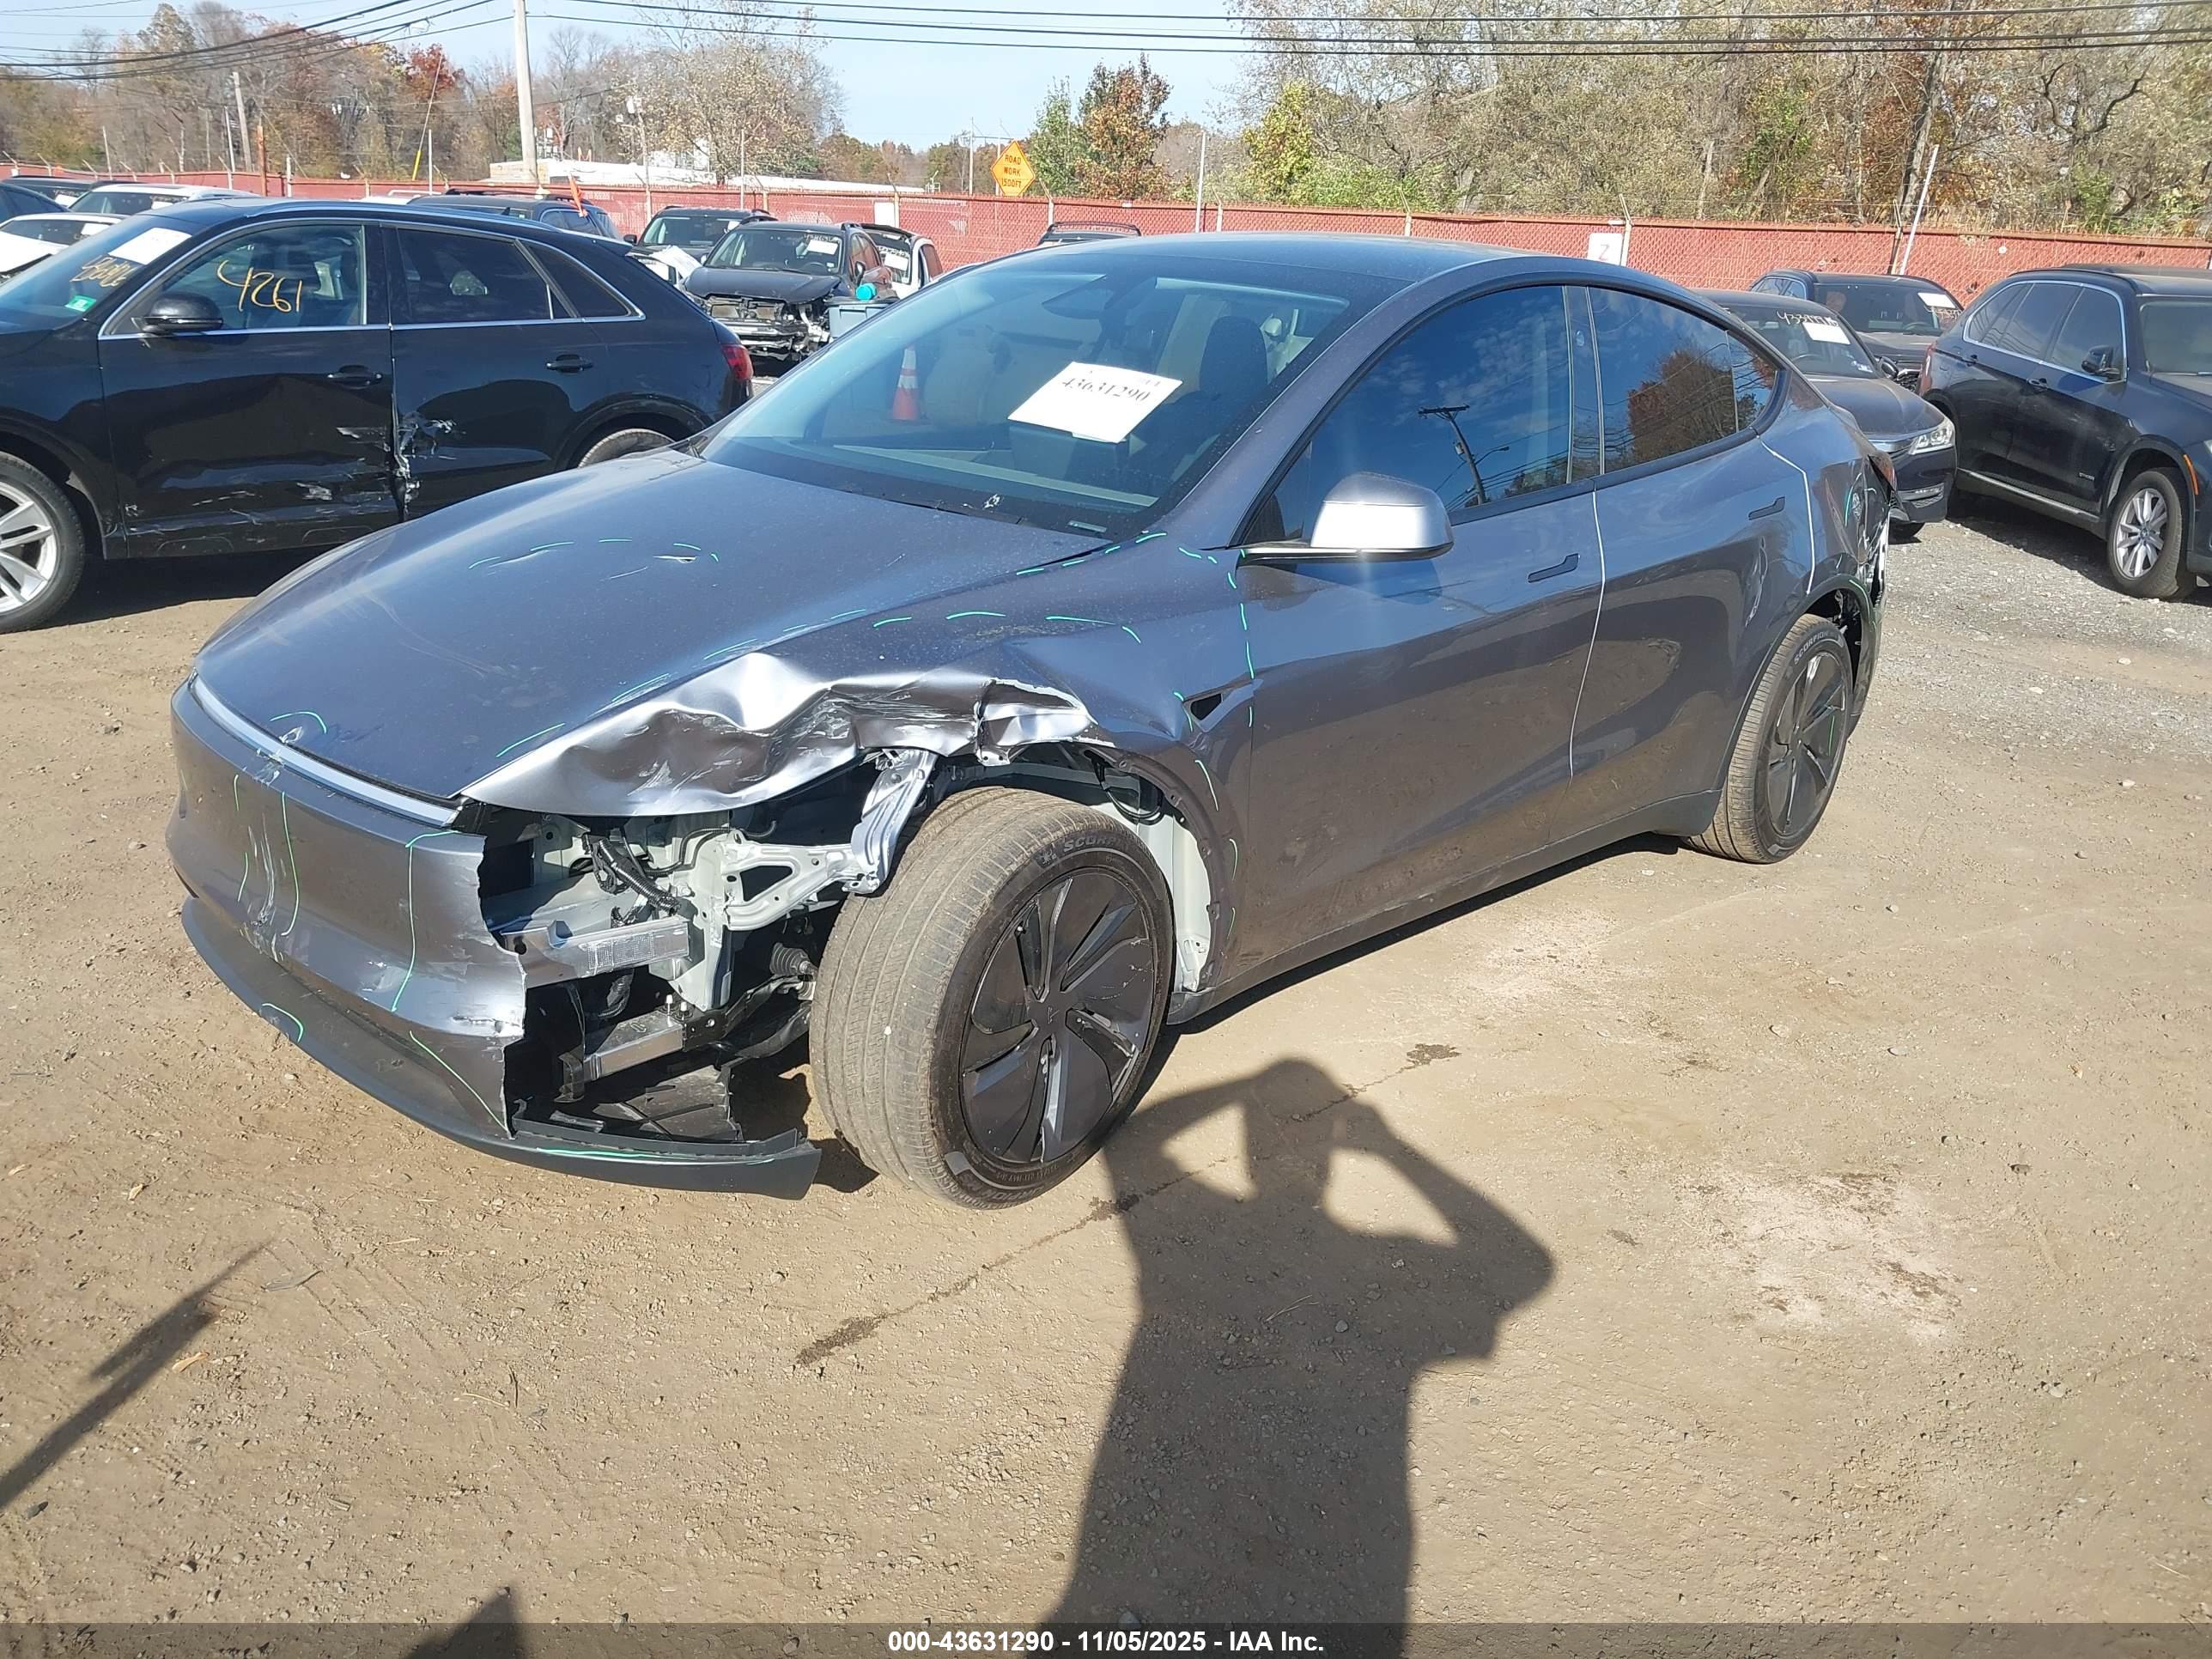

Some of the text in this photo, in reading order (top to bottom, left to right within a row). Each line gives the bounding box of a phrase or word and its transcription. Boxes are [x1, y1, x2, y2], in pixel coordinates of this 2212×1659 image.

[1005, 155, 1022, 165] ROAD
[1004, 167, 1021, 177] WORK
[1001, 178, 1022, 188] 1500FT
[216, 259, 302, 313] 4261
[1061, 377, 1152, 402] 43631290
